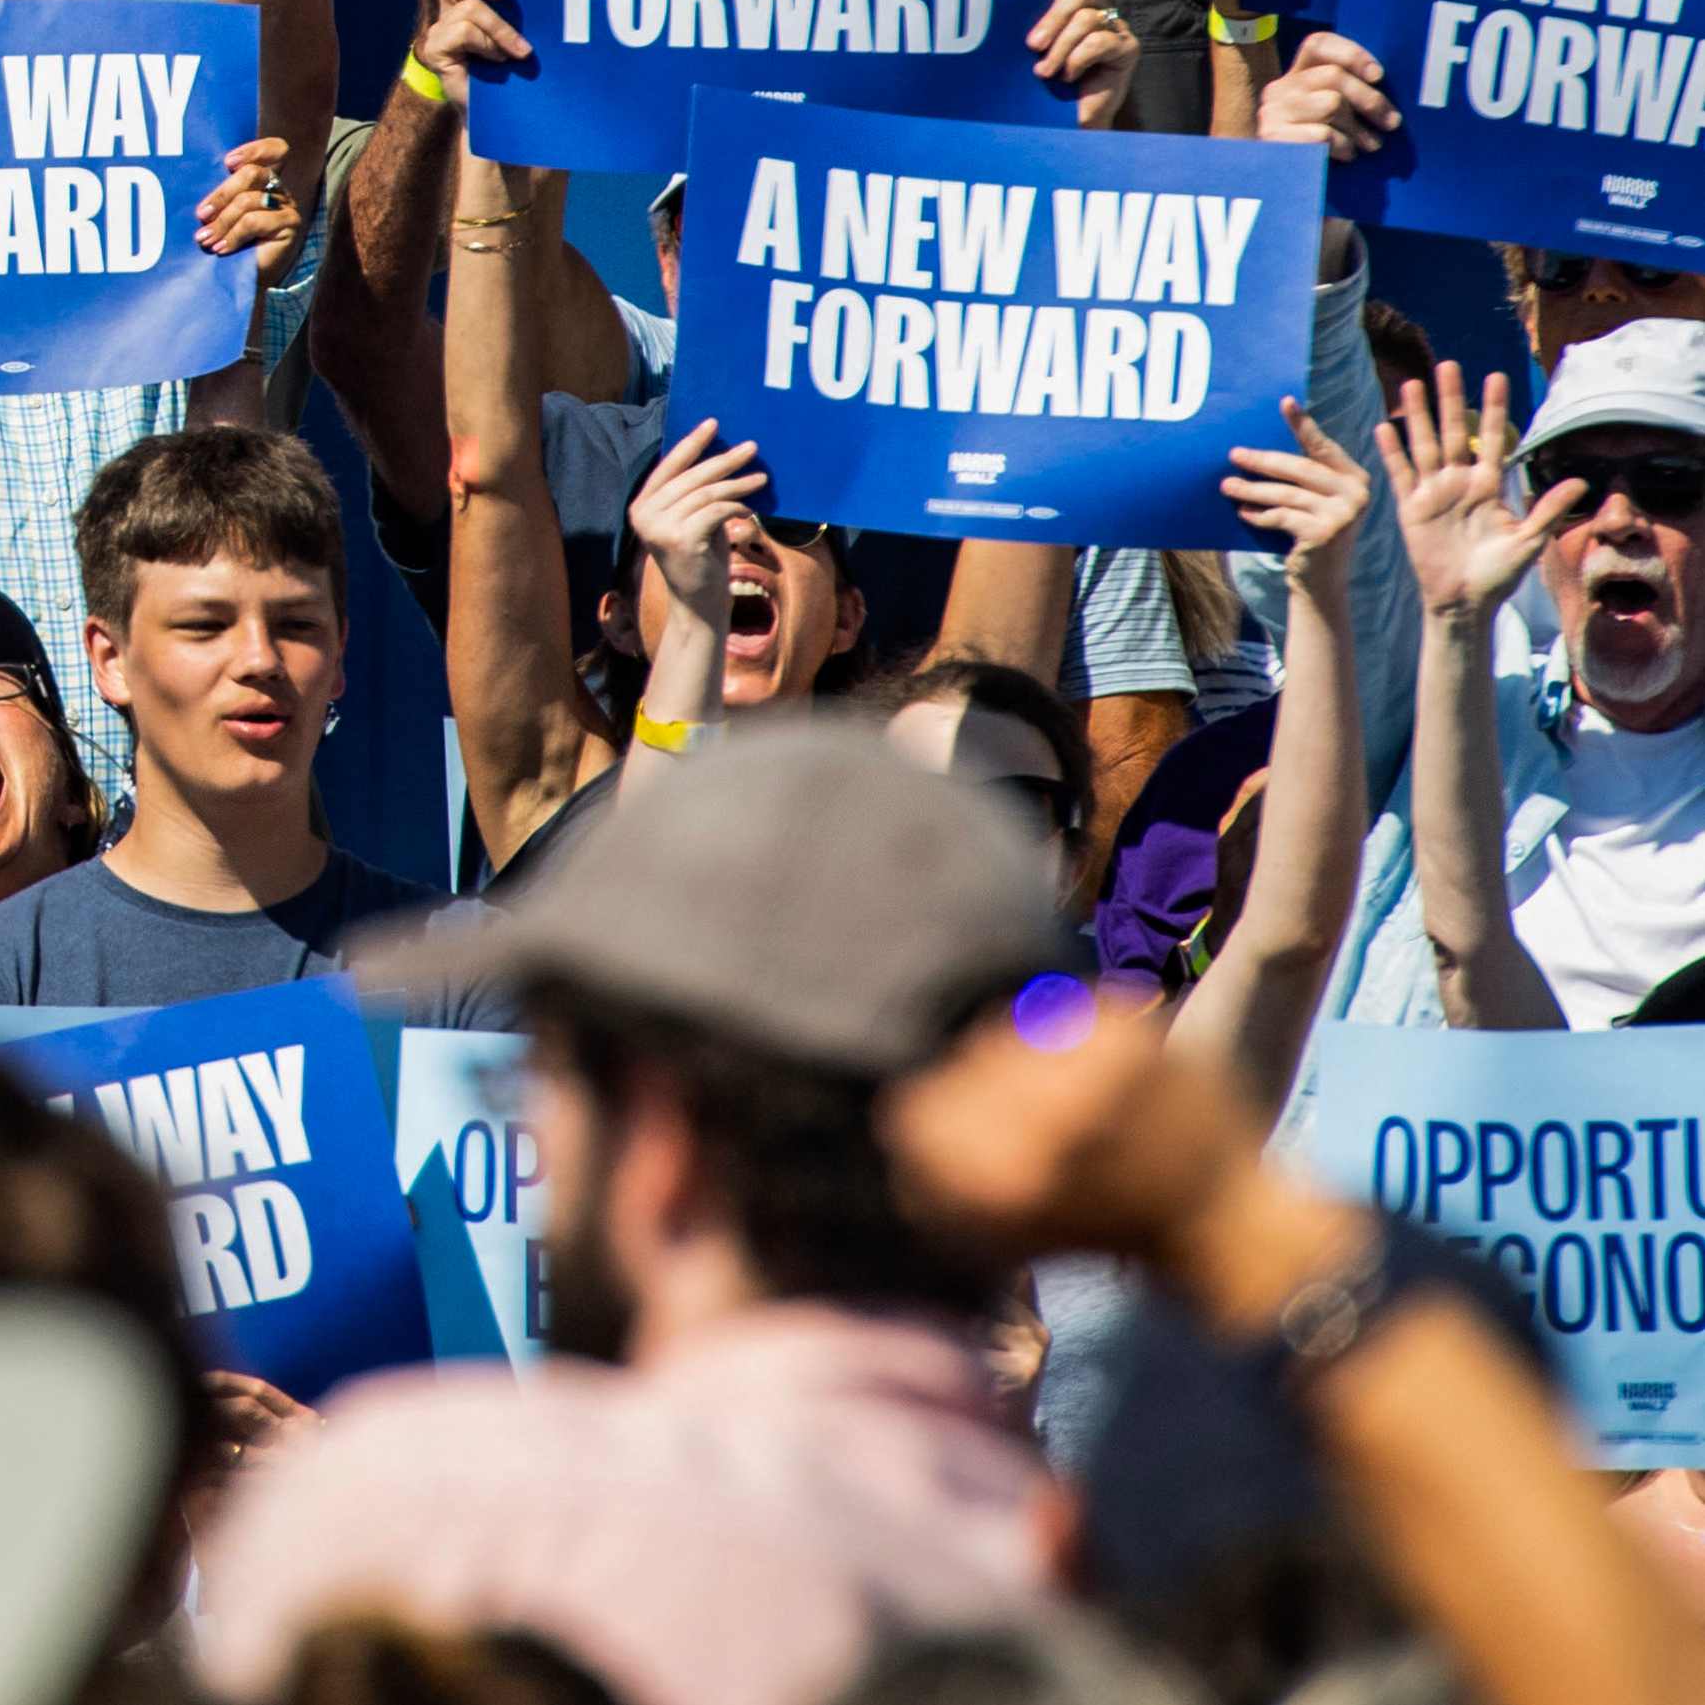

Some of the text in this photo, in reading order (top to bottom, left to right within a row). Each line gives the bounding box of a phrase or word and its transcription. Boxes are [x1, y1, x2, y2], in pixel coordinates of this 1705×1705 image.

[2, 54, 202, 158] WAY
[1419, 0, 1705, 148] FORWA
[736, 156, 1262, 307] A NEW WAY
[1601, 173, 1659, 201] HARRIS
[764, 278, 1212, 423] FORWARD
[949, 451, 1006, 475] HARRIS
[1620, 1380, 1677, 1402] HARRIS
